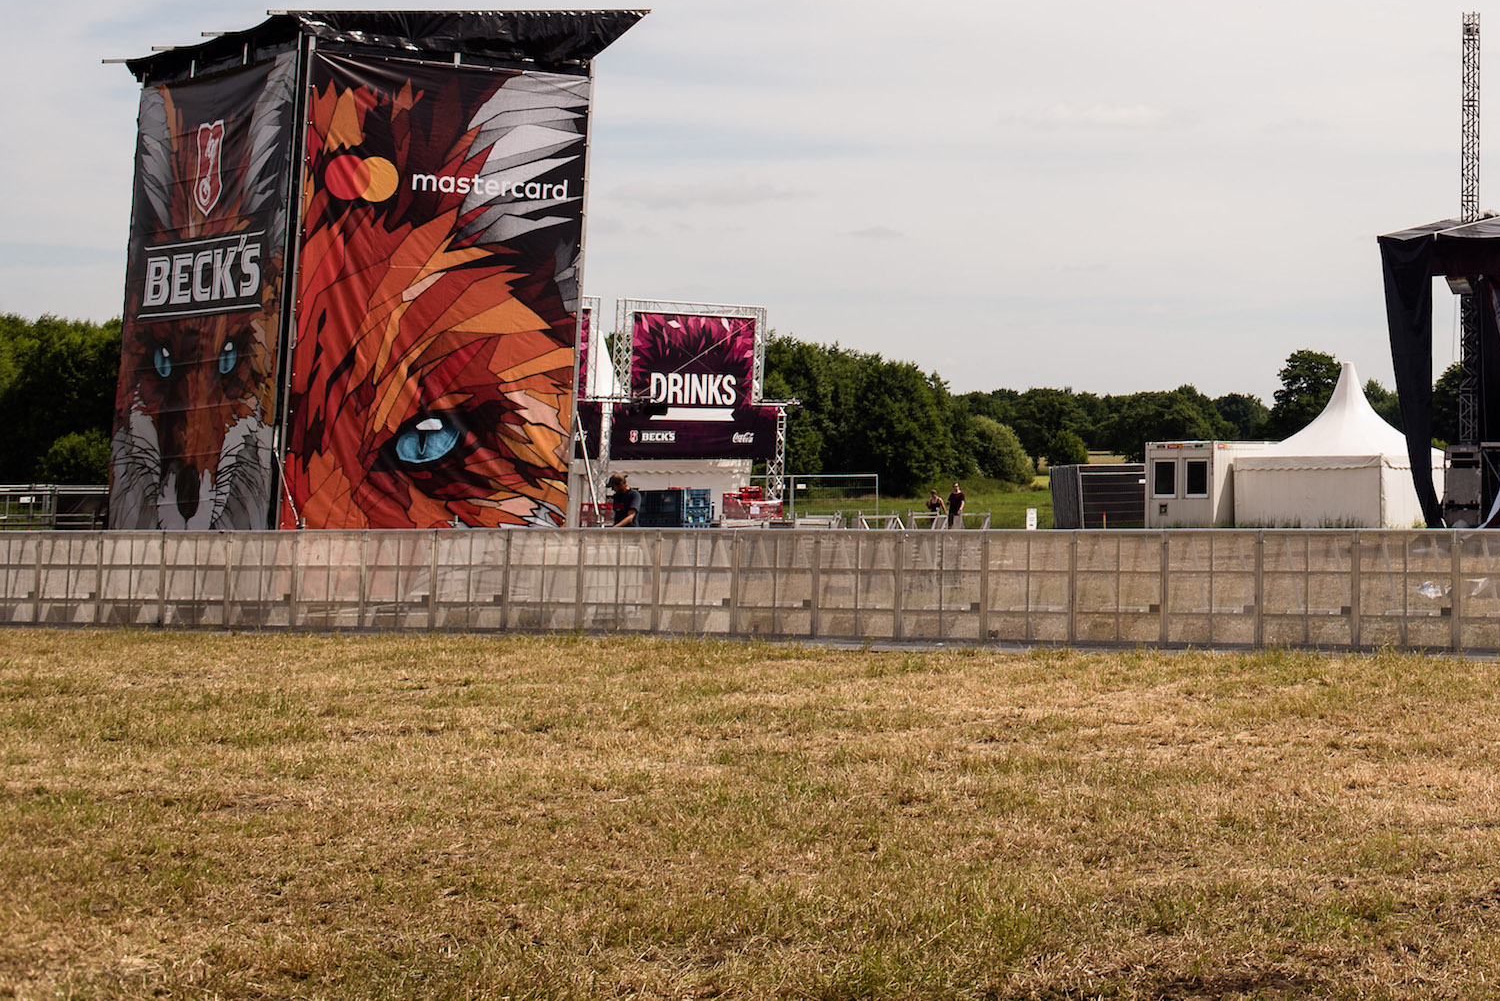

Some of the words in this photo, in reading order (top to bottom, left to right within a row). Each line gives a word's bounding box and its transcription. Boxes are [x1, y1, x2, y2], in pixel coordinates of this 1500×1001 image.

[411, 173, 569, 201] mastercard
[142, 234, 262, 307] BECK'S
[650, 371, 737, 406] DRINKS
[641, 430, 676, 442] BECK'S
